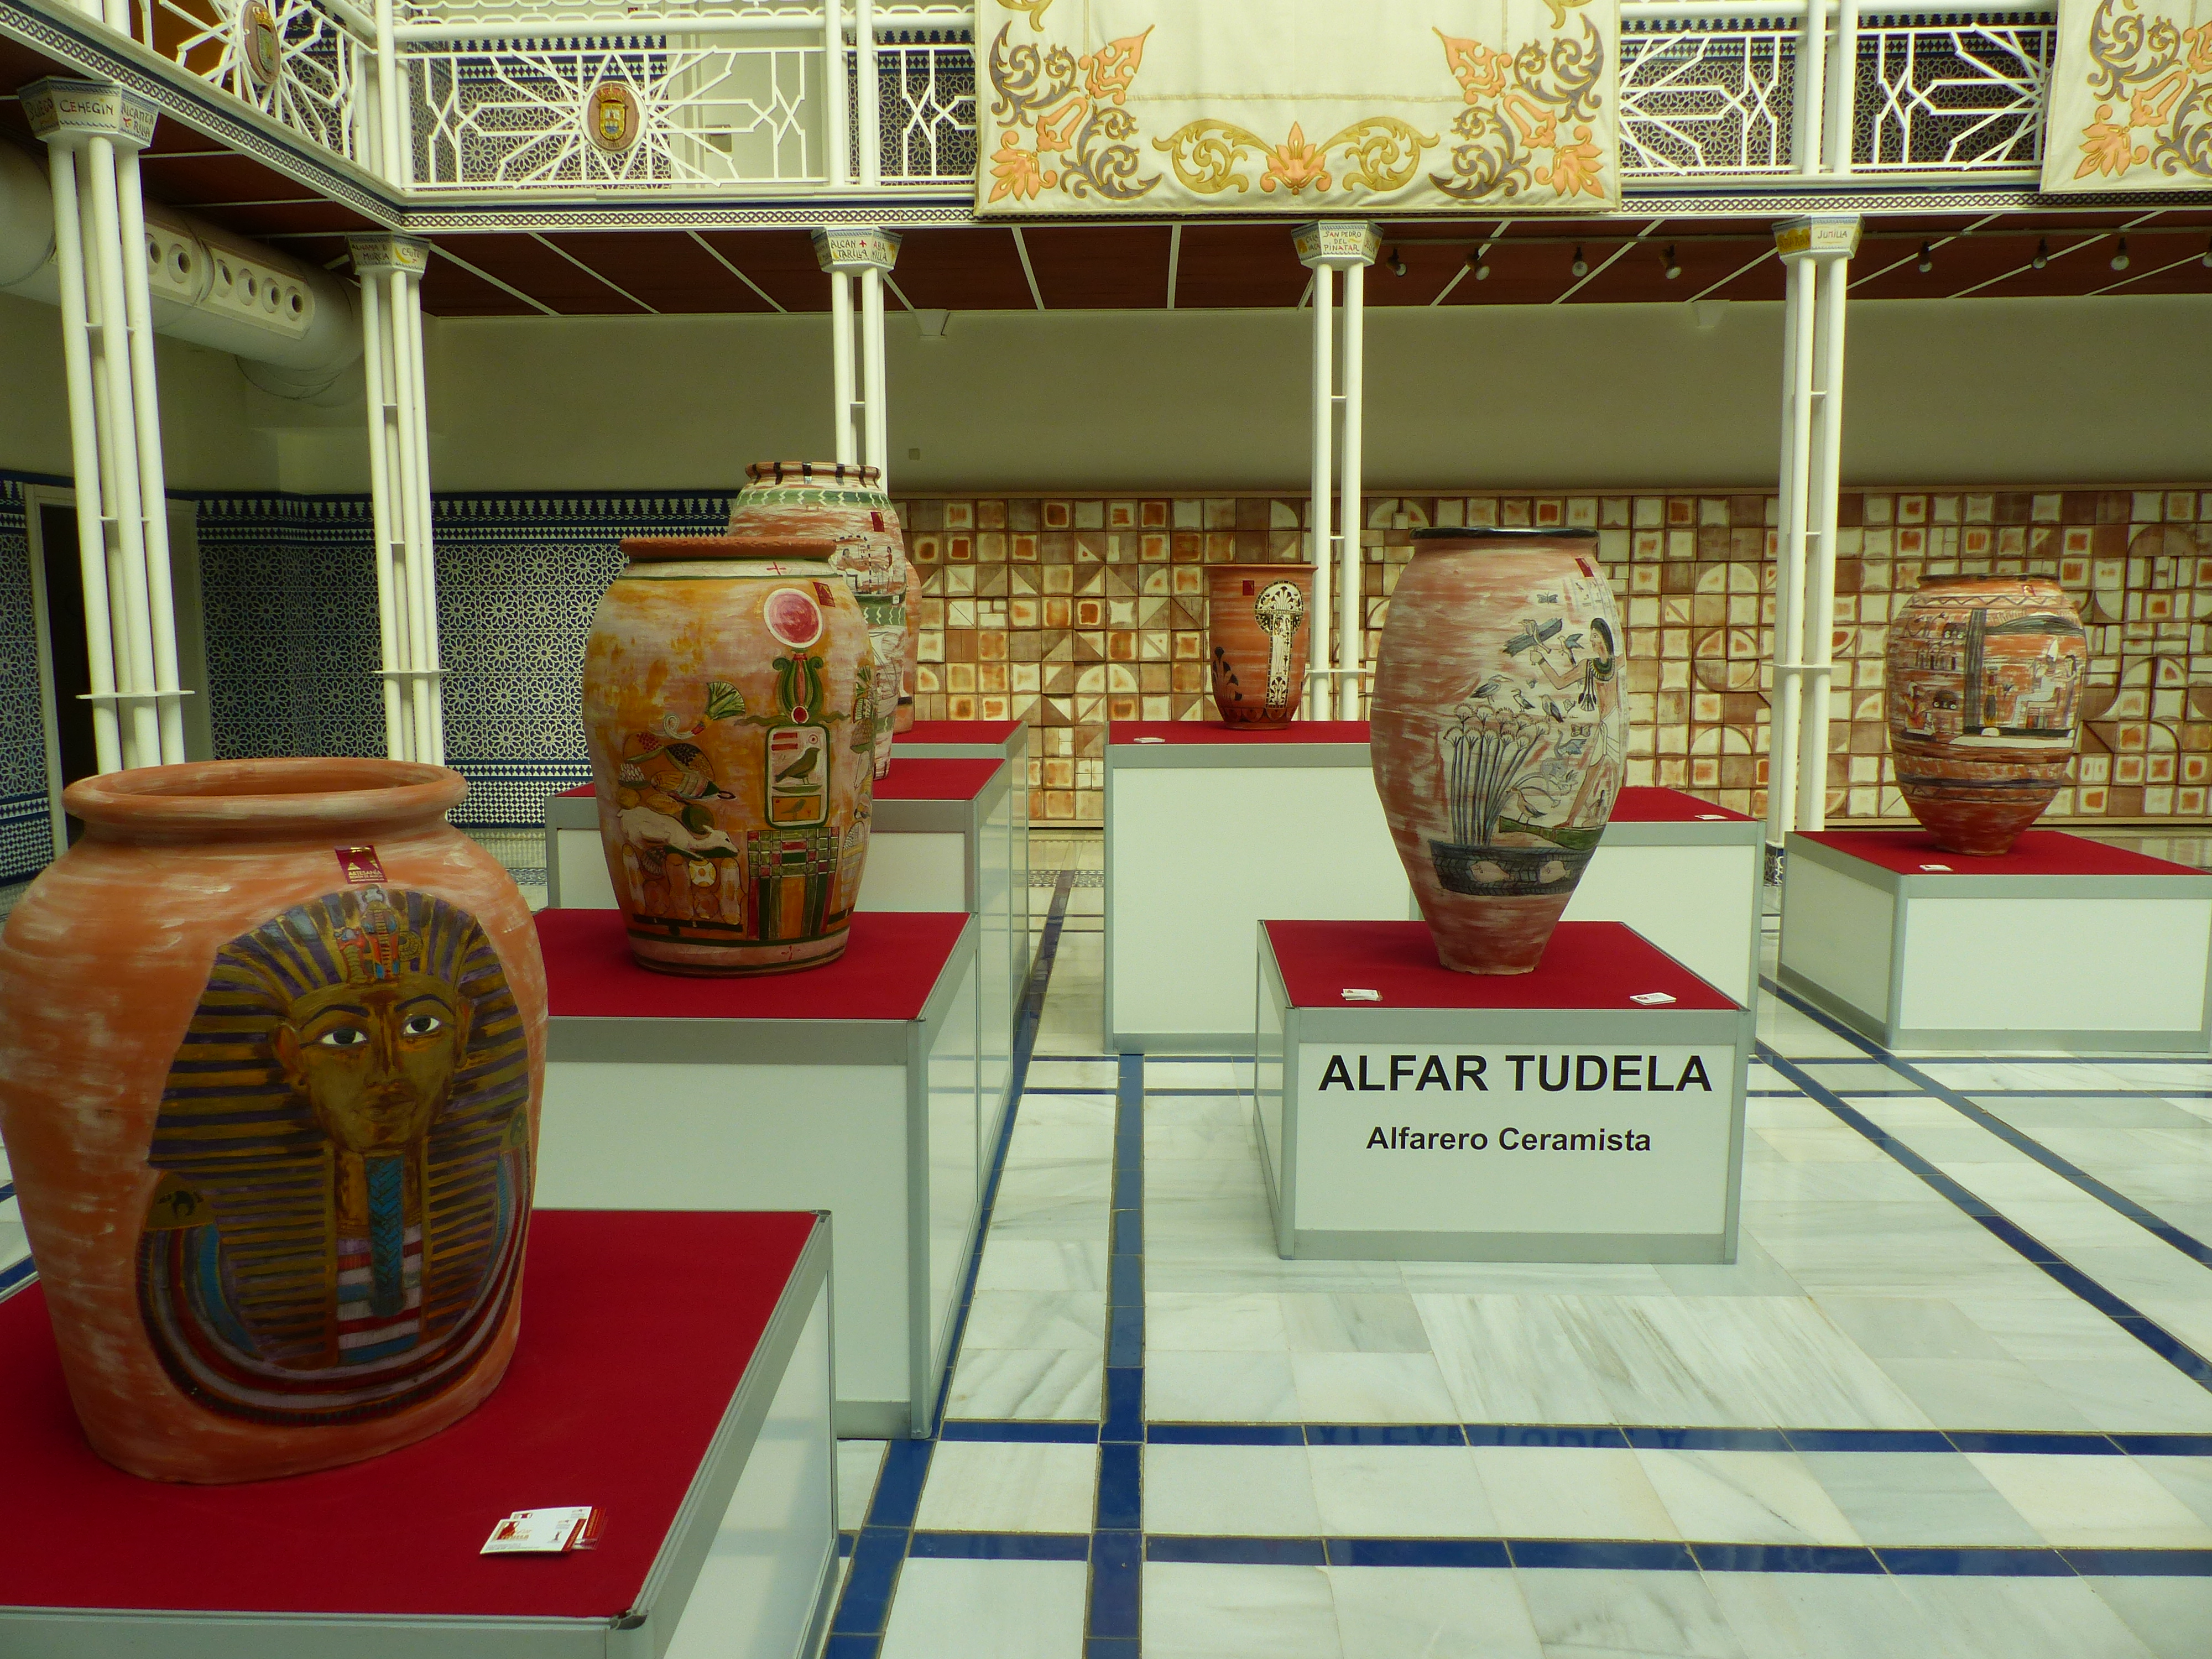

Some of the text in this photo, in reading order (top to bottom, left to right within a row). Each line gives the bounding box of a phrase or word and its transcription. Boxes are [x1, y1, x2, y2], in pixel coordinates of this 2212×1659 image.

[831, 239, 856, 249] ALCAN
[873, 240, 885, 252] ABA
[1324, 243, 1360, 252] PINATAR
[838, 249, 868, 259] TARILLA
[1318, 1054, 1713, 1092] ALFAR TUDELA
[1366, 1126, 1651, 1152] Alfarero Ceramista
